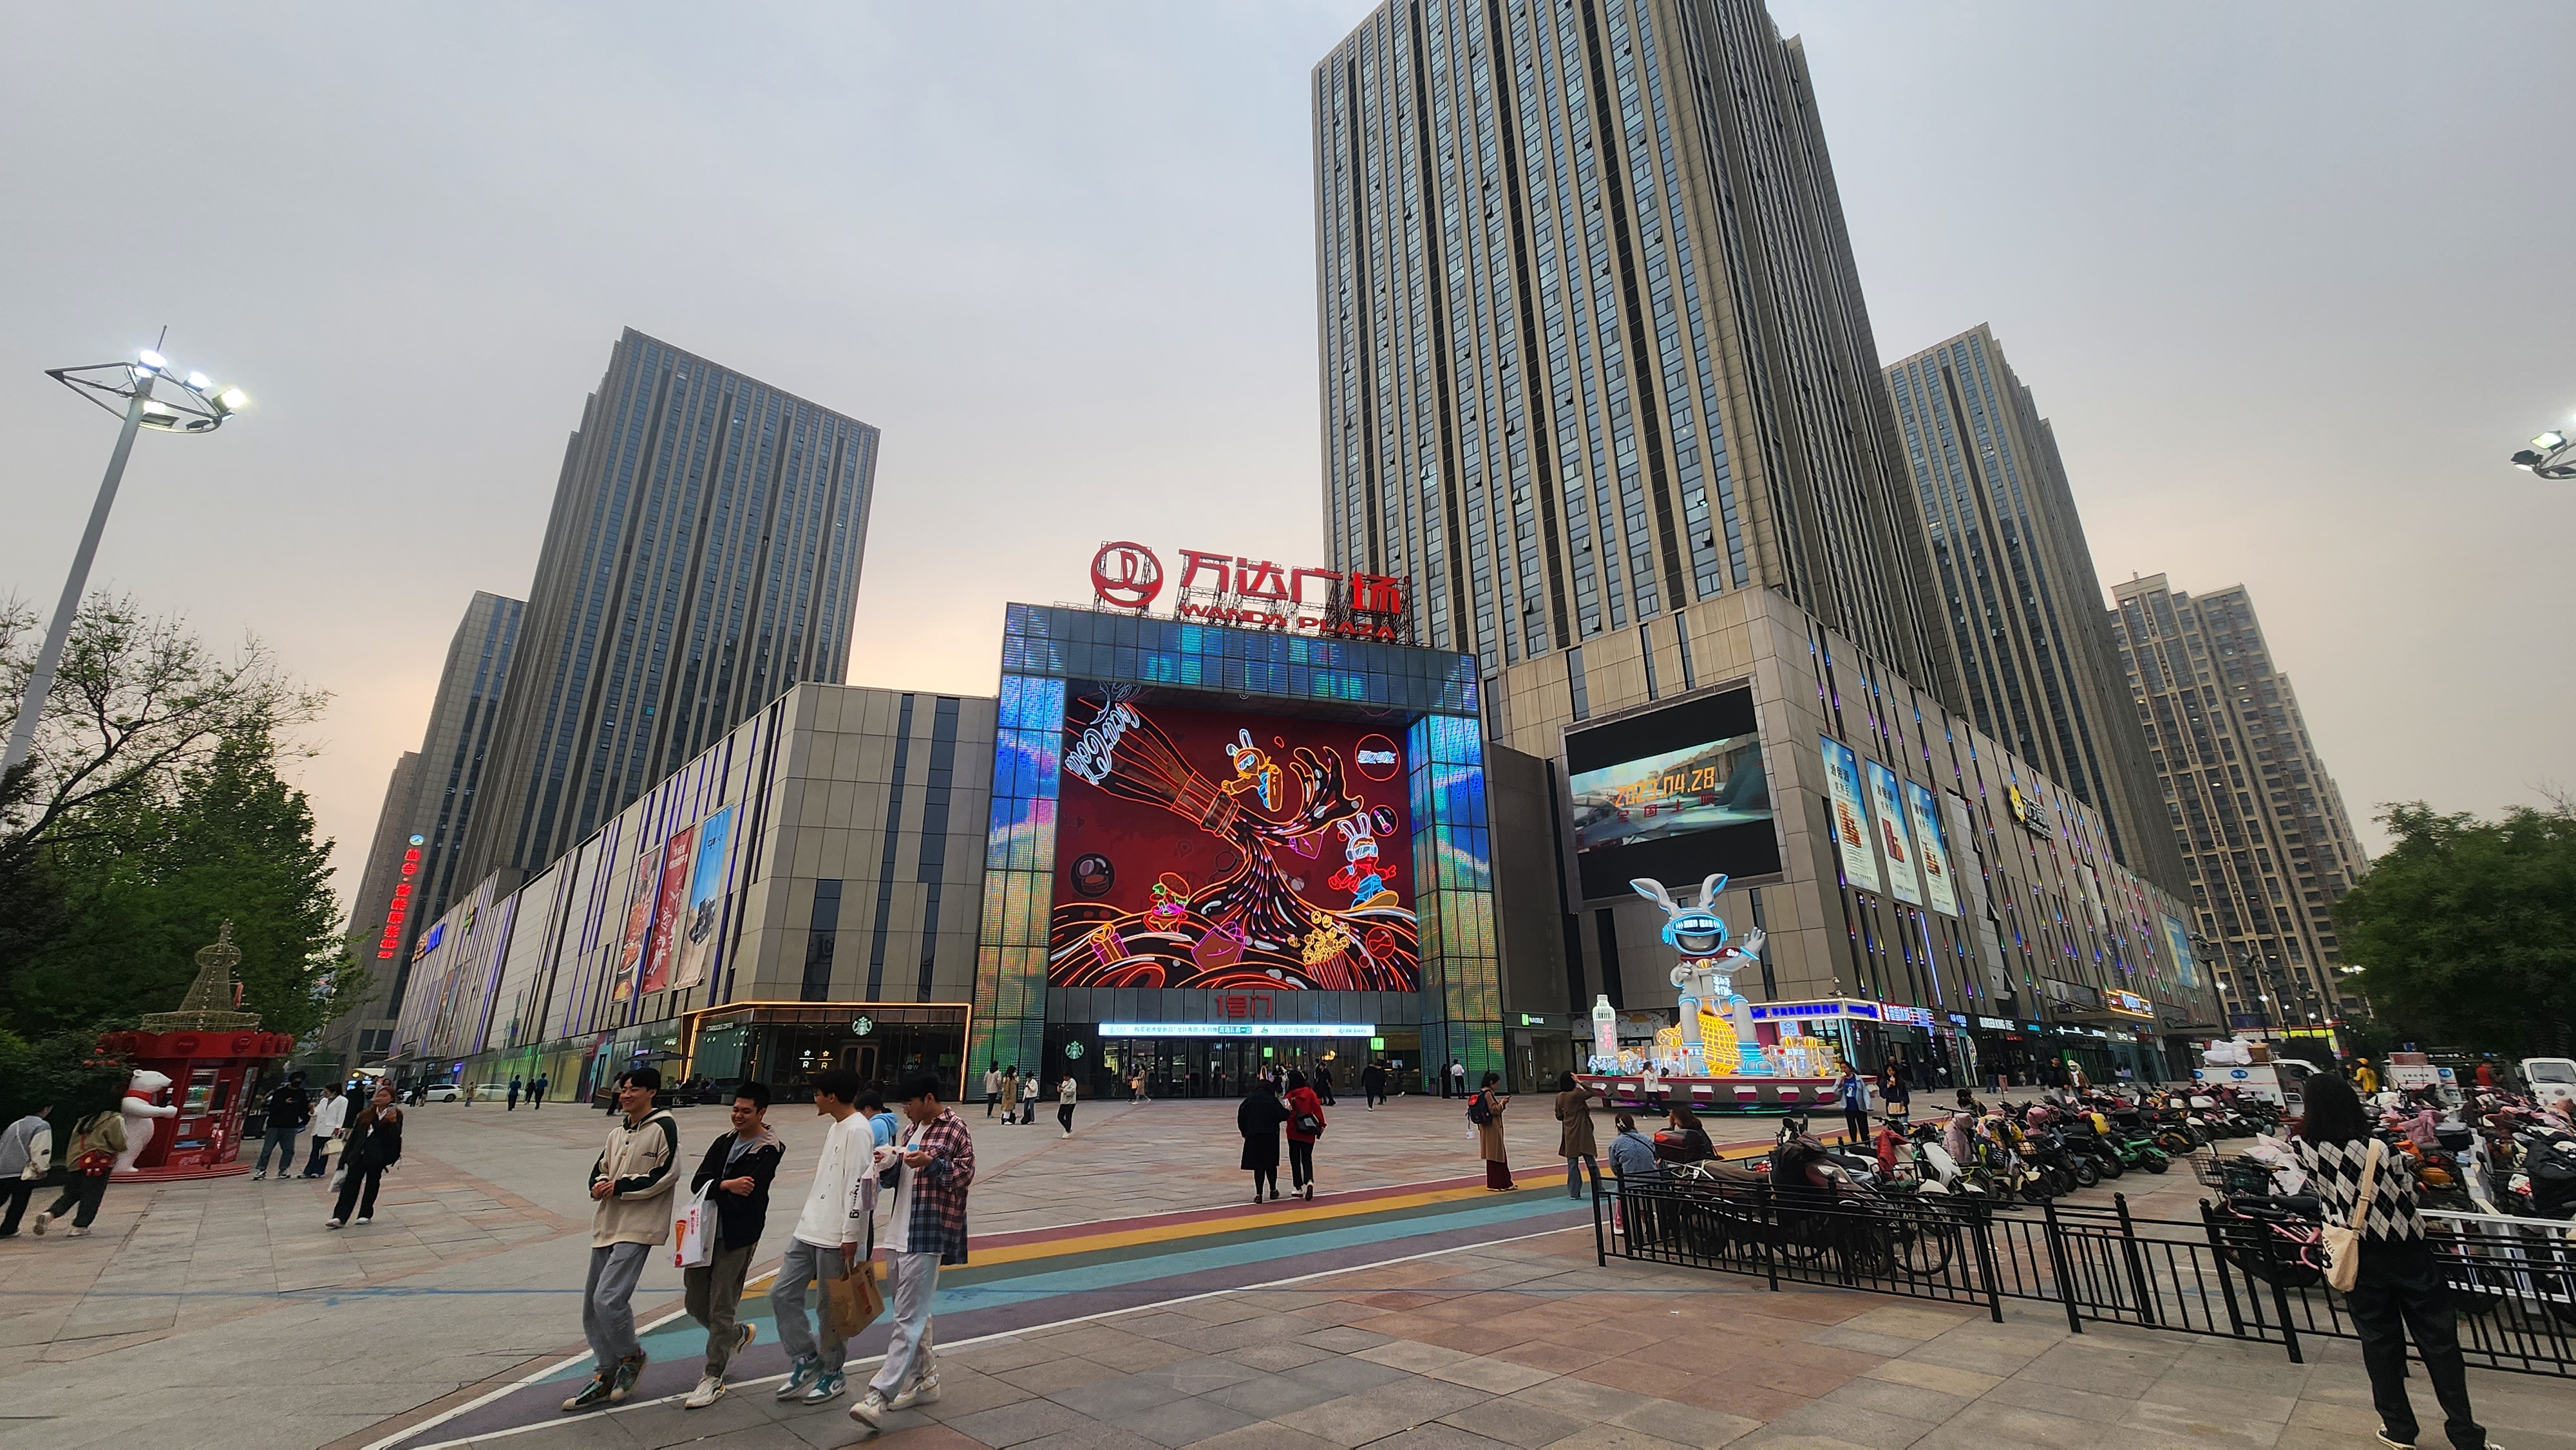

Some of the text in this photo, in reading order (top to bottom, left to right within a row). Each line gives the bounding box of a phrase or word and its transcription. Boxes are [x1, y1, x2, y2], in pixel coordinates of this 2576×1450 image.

[1179, 549, 1401, 614] 万达广场
[1180, 602, 1397, 639] WANDA PLAZA
[1615, 766, 1716, 808] 2023.04.28
[1215, 995, 1273, 1017] 1号门
